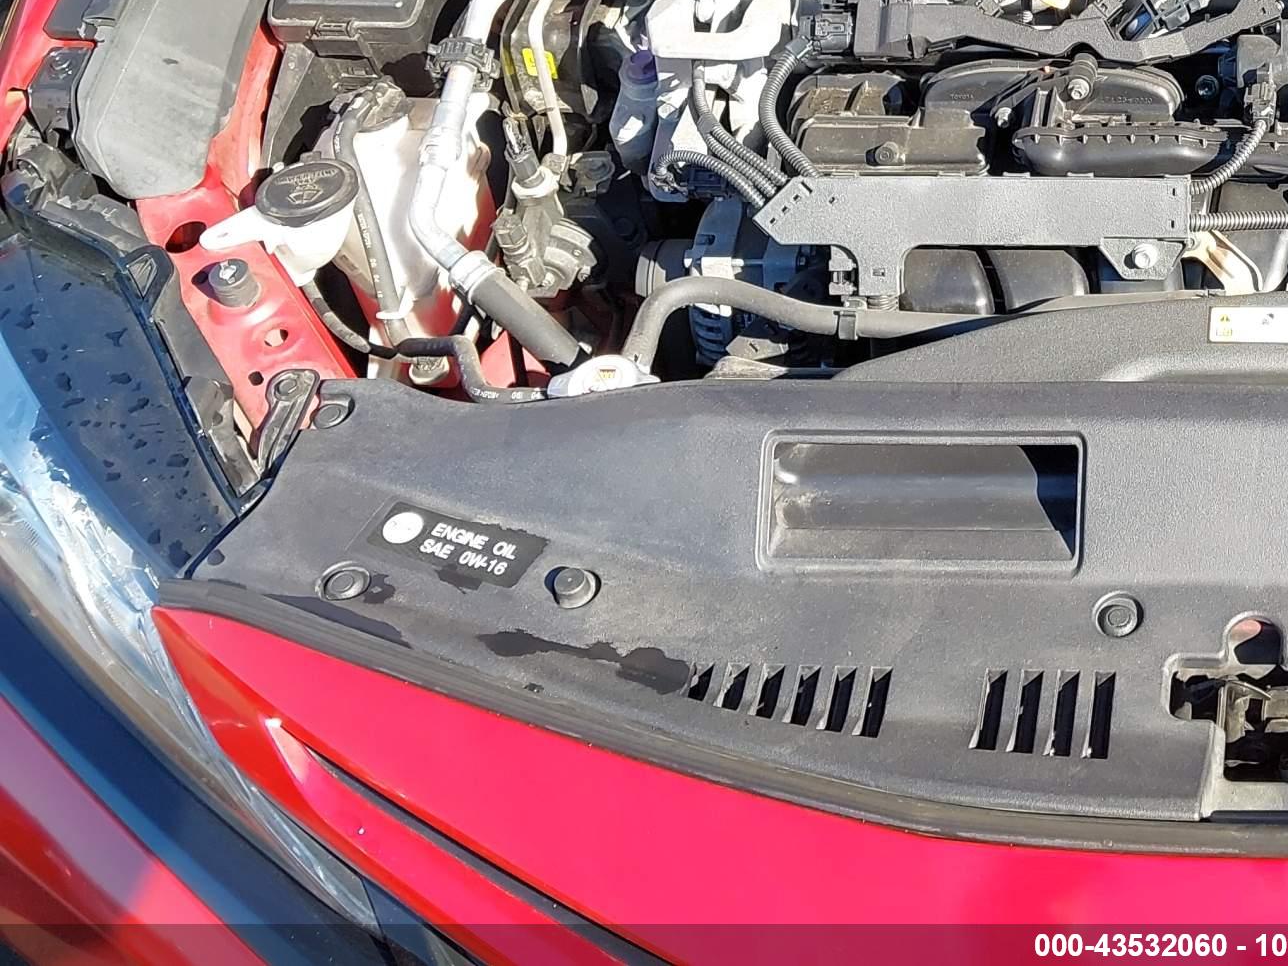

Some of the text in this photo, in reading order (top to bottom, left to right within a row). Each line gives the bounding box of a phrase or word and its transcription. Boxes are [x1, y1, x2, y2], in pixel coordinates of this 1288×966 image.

[419, 538, 508, 576] SAE 0W-16
[430, 522, 517, 561] ENGINE OIL
